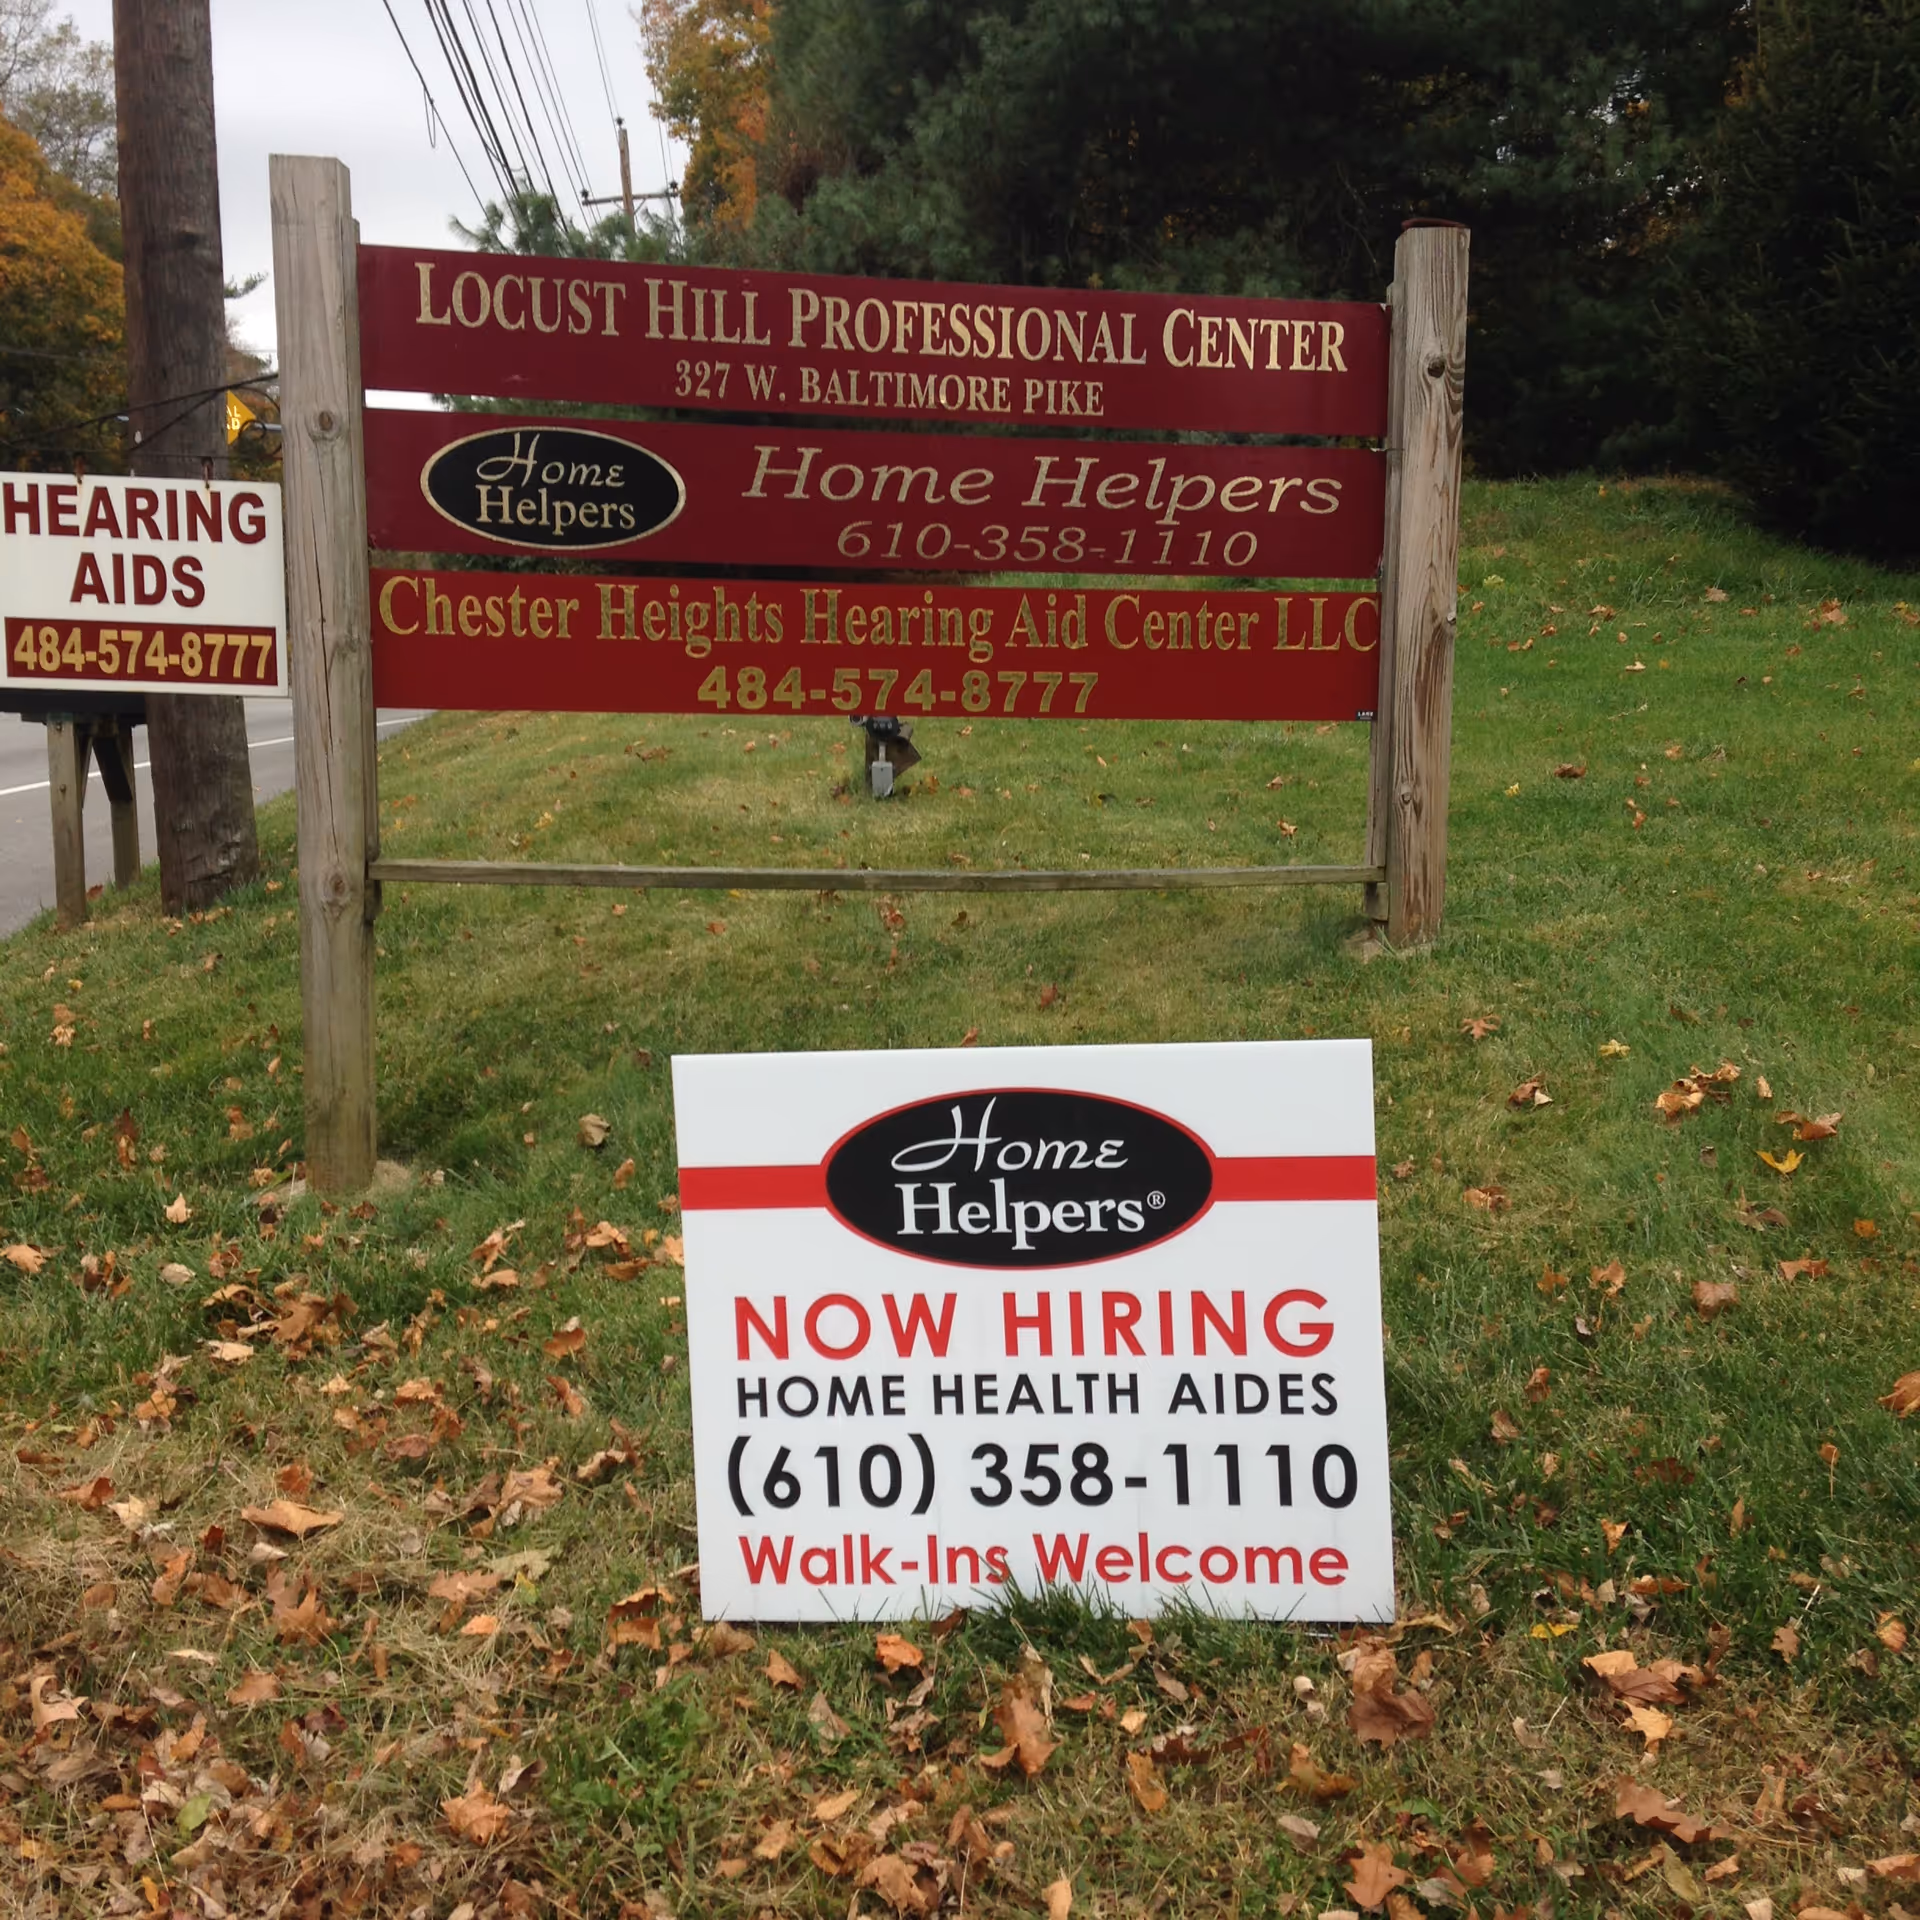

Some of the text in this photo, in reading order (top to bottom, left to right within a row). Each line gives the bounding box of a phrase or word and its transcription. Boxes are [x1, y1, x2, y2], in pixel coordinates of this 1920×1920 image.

[414, 262, 1348, 372] LOCUST HILL PROFESSIONAL CENTER
[675, 360, 1104, 416] 327 W. BALTIMORE PIKE
[476, 432, 626, 489] Home
[742, 445, 1343, 525] Home Helpers
[2, 482, 267, 545] HEARING
[475, 484, 636, 536] Helpers
[836, 520, 1258, 567] 610-358-1110
[70, 551, 206, 608] AIDS
[379, 576, 1378, 663] Chester Heights Hearing Aid Center LLC
[13, 625, 273, 679] 484-574-8777
[697, 666, 1099, 713] 484-574-8777
[891, 1096, 1129, 1173] Home
[734, 1288, 1335, 1360] NOW HIRING
[737, 1372, 1339, 1419] HOME HEALTH AIDES
[727, 1432, 1358, 1517] (610) 358-1110
[738, 1532, 1349, 1586] Walk-Ins Welcome
